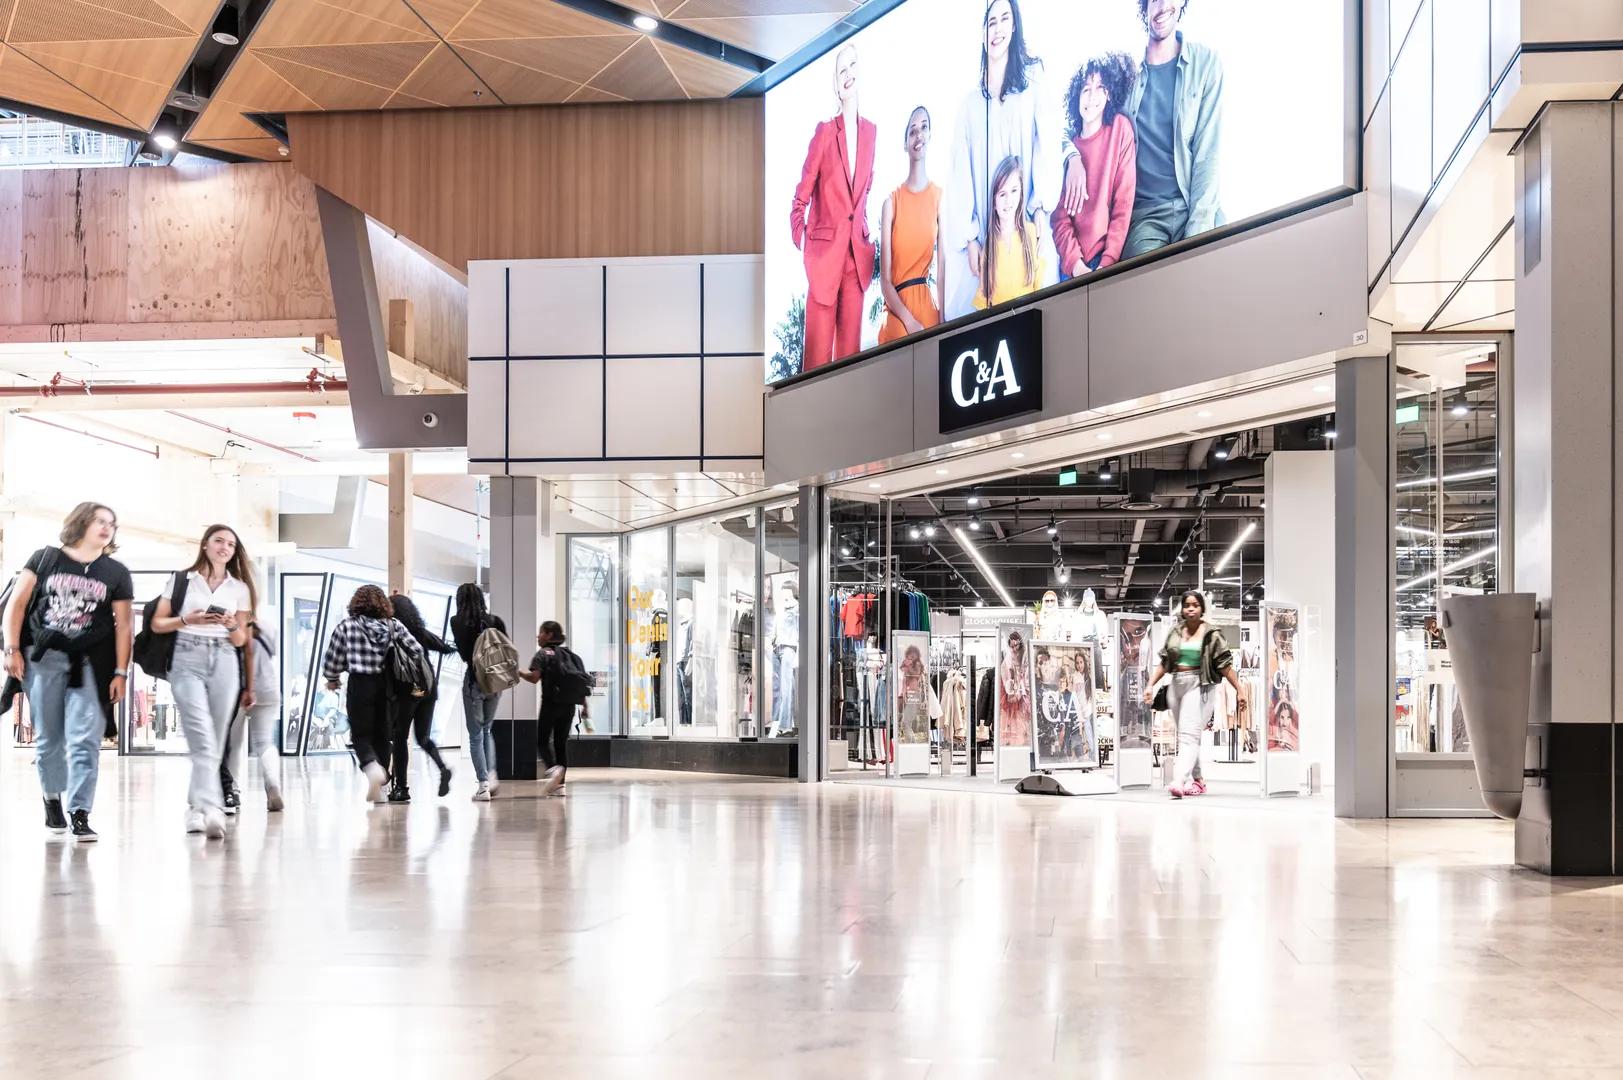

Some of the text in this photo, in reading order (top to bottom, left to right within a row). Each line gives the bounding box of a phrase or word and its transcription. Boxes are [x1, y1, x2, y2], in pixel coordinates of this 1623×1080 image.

[951, 339, 1021, 407] C&A
[628, 585, 654, 610] Our
[627, 616, 668, 644] Denim
[1041, 690, 1085, 723] C&A
